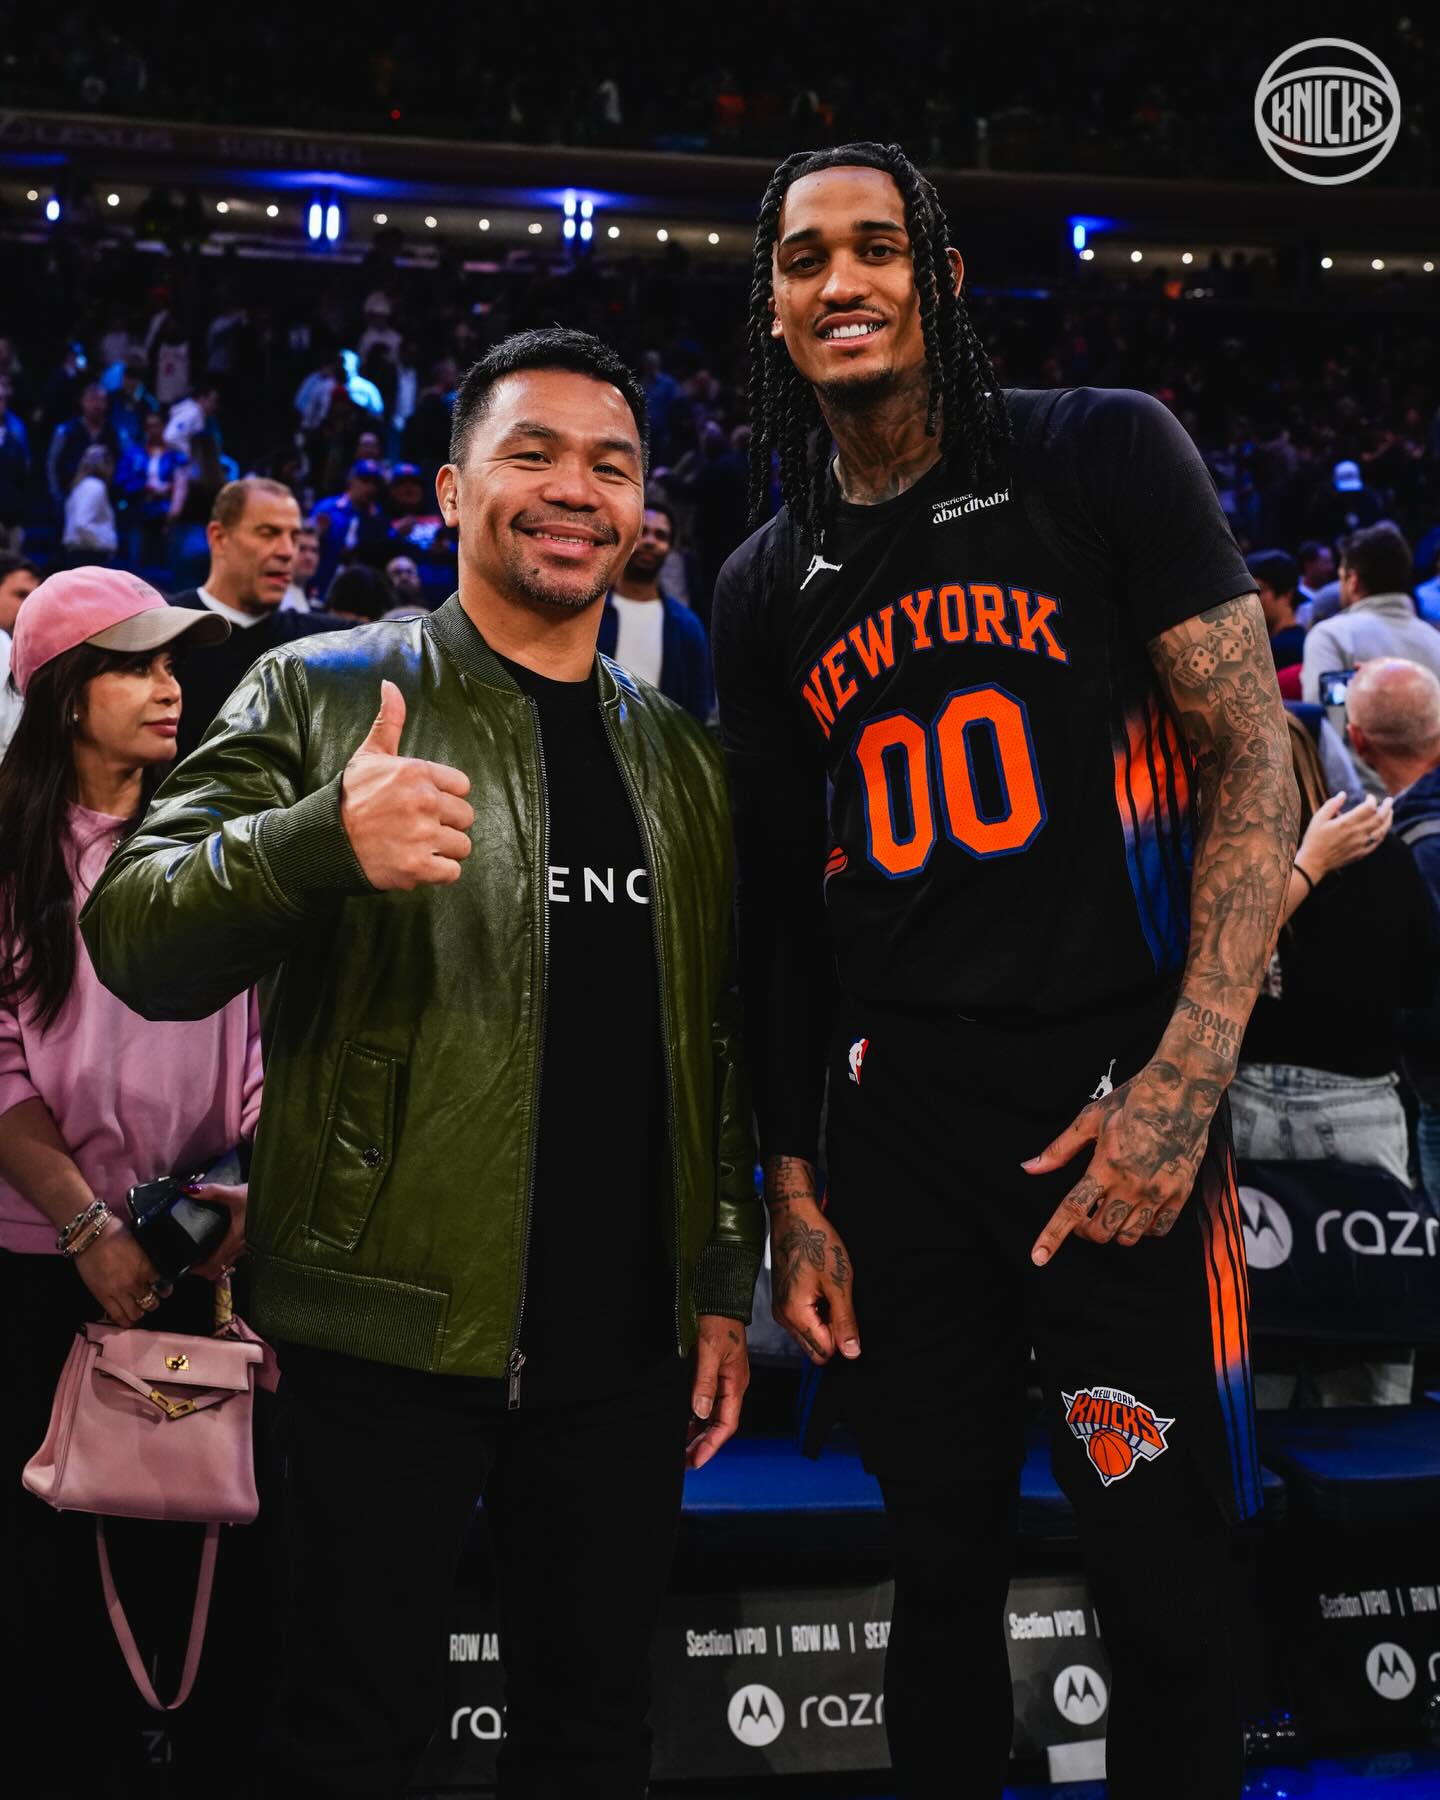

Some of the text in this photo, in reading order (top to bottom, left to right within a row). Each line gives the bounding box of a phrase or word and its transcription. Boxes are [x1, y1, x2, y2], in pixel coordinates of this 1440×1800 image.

[932, 493, 974, 509] experience
[933, 488, 1010, 524] abu dhabi
[801, 582, 1070, 741] NEW YORK
[851, 681, 1048, 880] 00
[1315, 1209, 1440, 1257] razr
[1091, 1389, 1134, 1407] NEW YORK
[1067, 1392, 1165, 1449] KNICKS
[686, 1630, 733, 1657] Section
[791, 1625, 821, 1652] ROW
[822, 1623, 841, 1651] AA
[1008, 1612, 1055, 1640] Section
[449, 1632, 499, 1662] ROW AA
